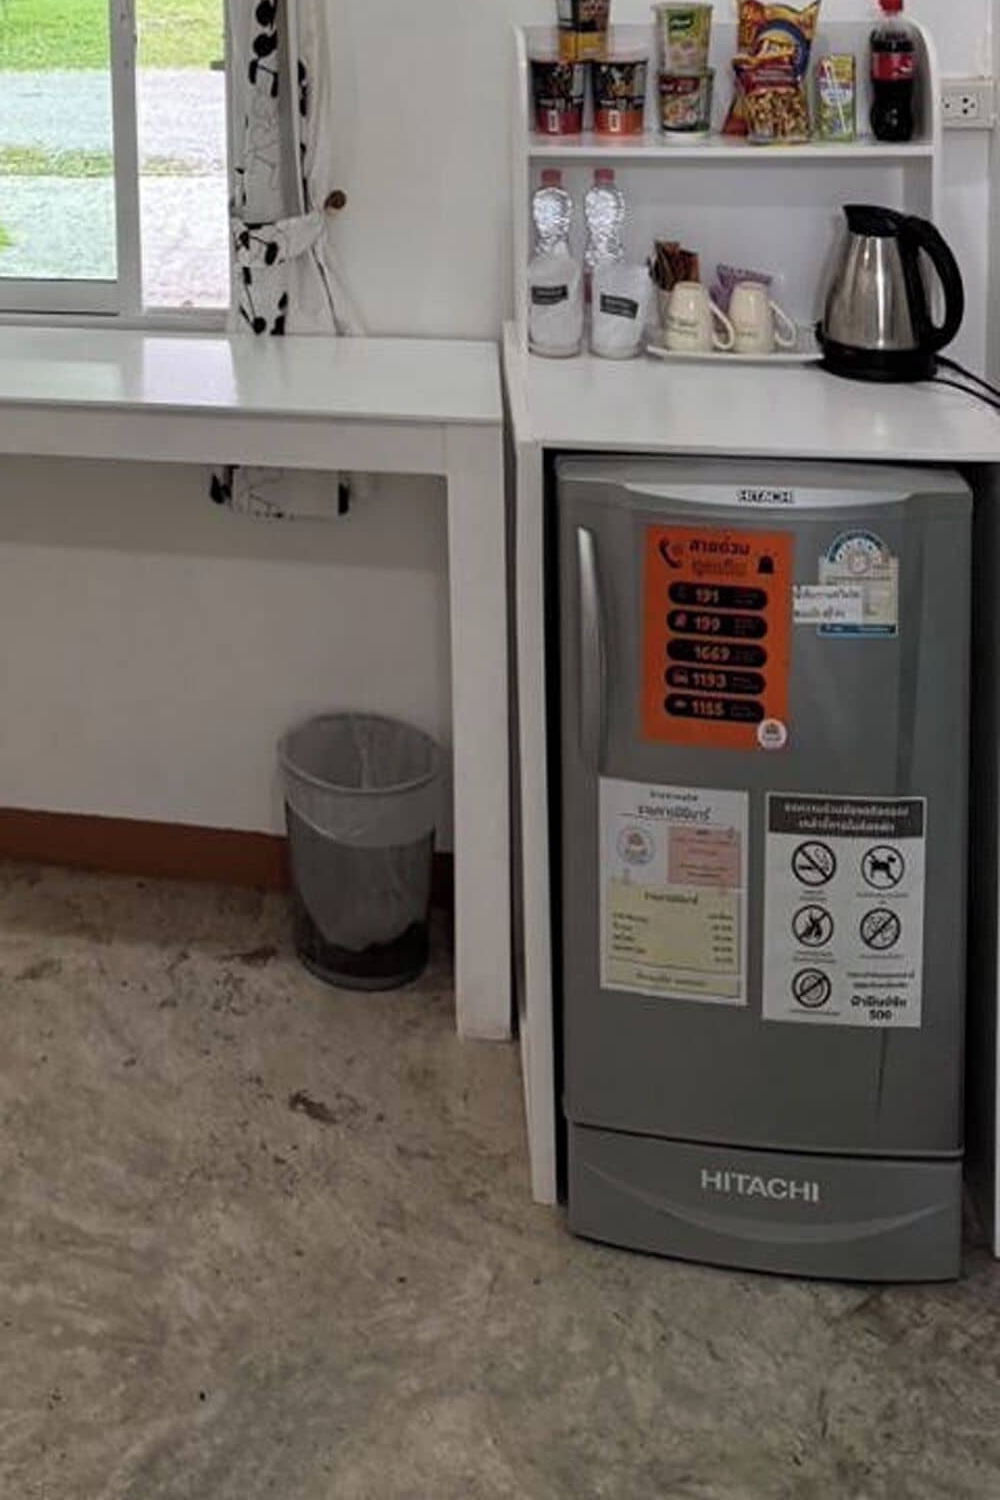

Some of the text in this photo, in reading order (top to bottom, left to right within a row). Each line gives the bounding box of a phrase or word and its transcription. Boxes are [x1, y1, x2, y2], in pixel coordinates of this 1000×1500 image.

[737, 489, 793, 503] HITACHI
[689, 534, 751, 555] สายด่วน
[695, 587, 720, 604] 191
[694, 615, 721, 632] 199
[693, 644, 730, 661] 1669
[868, 1009, 893, 1021] 500
[700, 1168, 819, 1202] HITACHI
